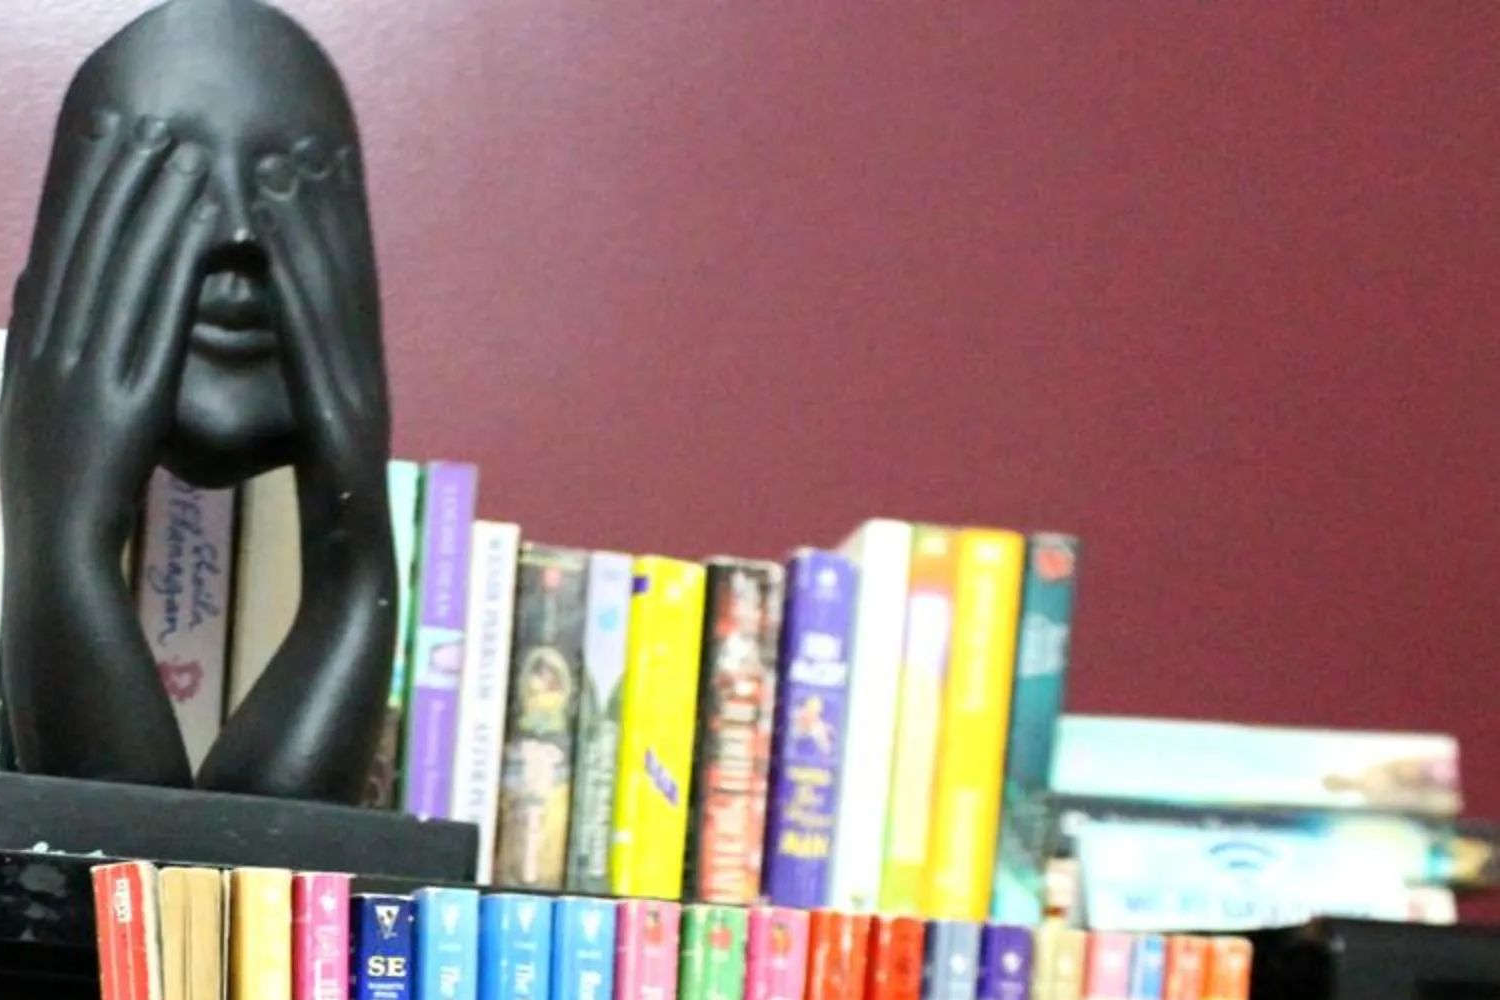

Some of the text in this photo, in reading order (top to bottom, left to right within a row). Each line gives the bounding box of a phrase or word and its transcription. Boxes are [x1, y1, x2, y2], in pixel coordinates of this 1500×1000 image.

[367, 954, 407, 977] SE
[439, 964, 460, 996] The
[514, 962, 536, 994] The
